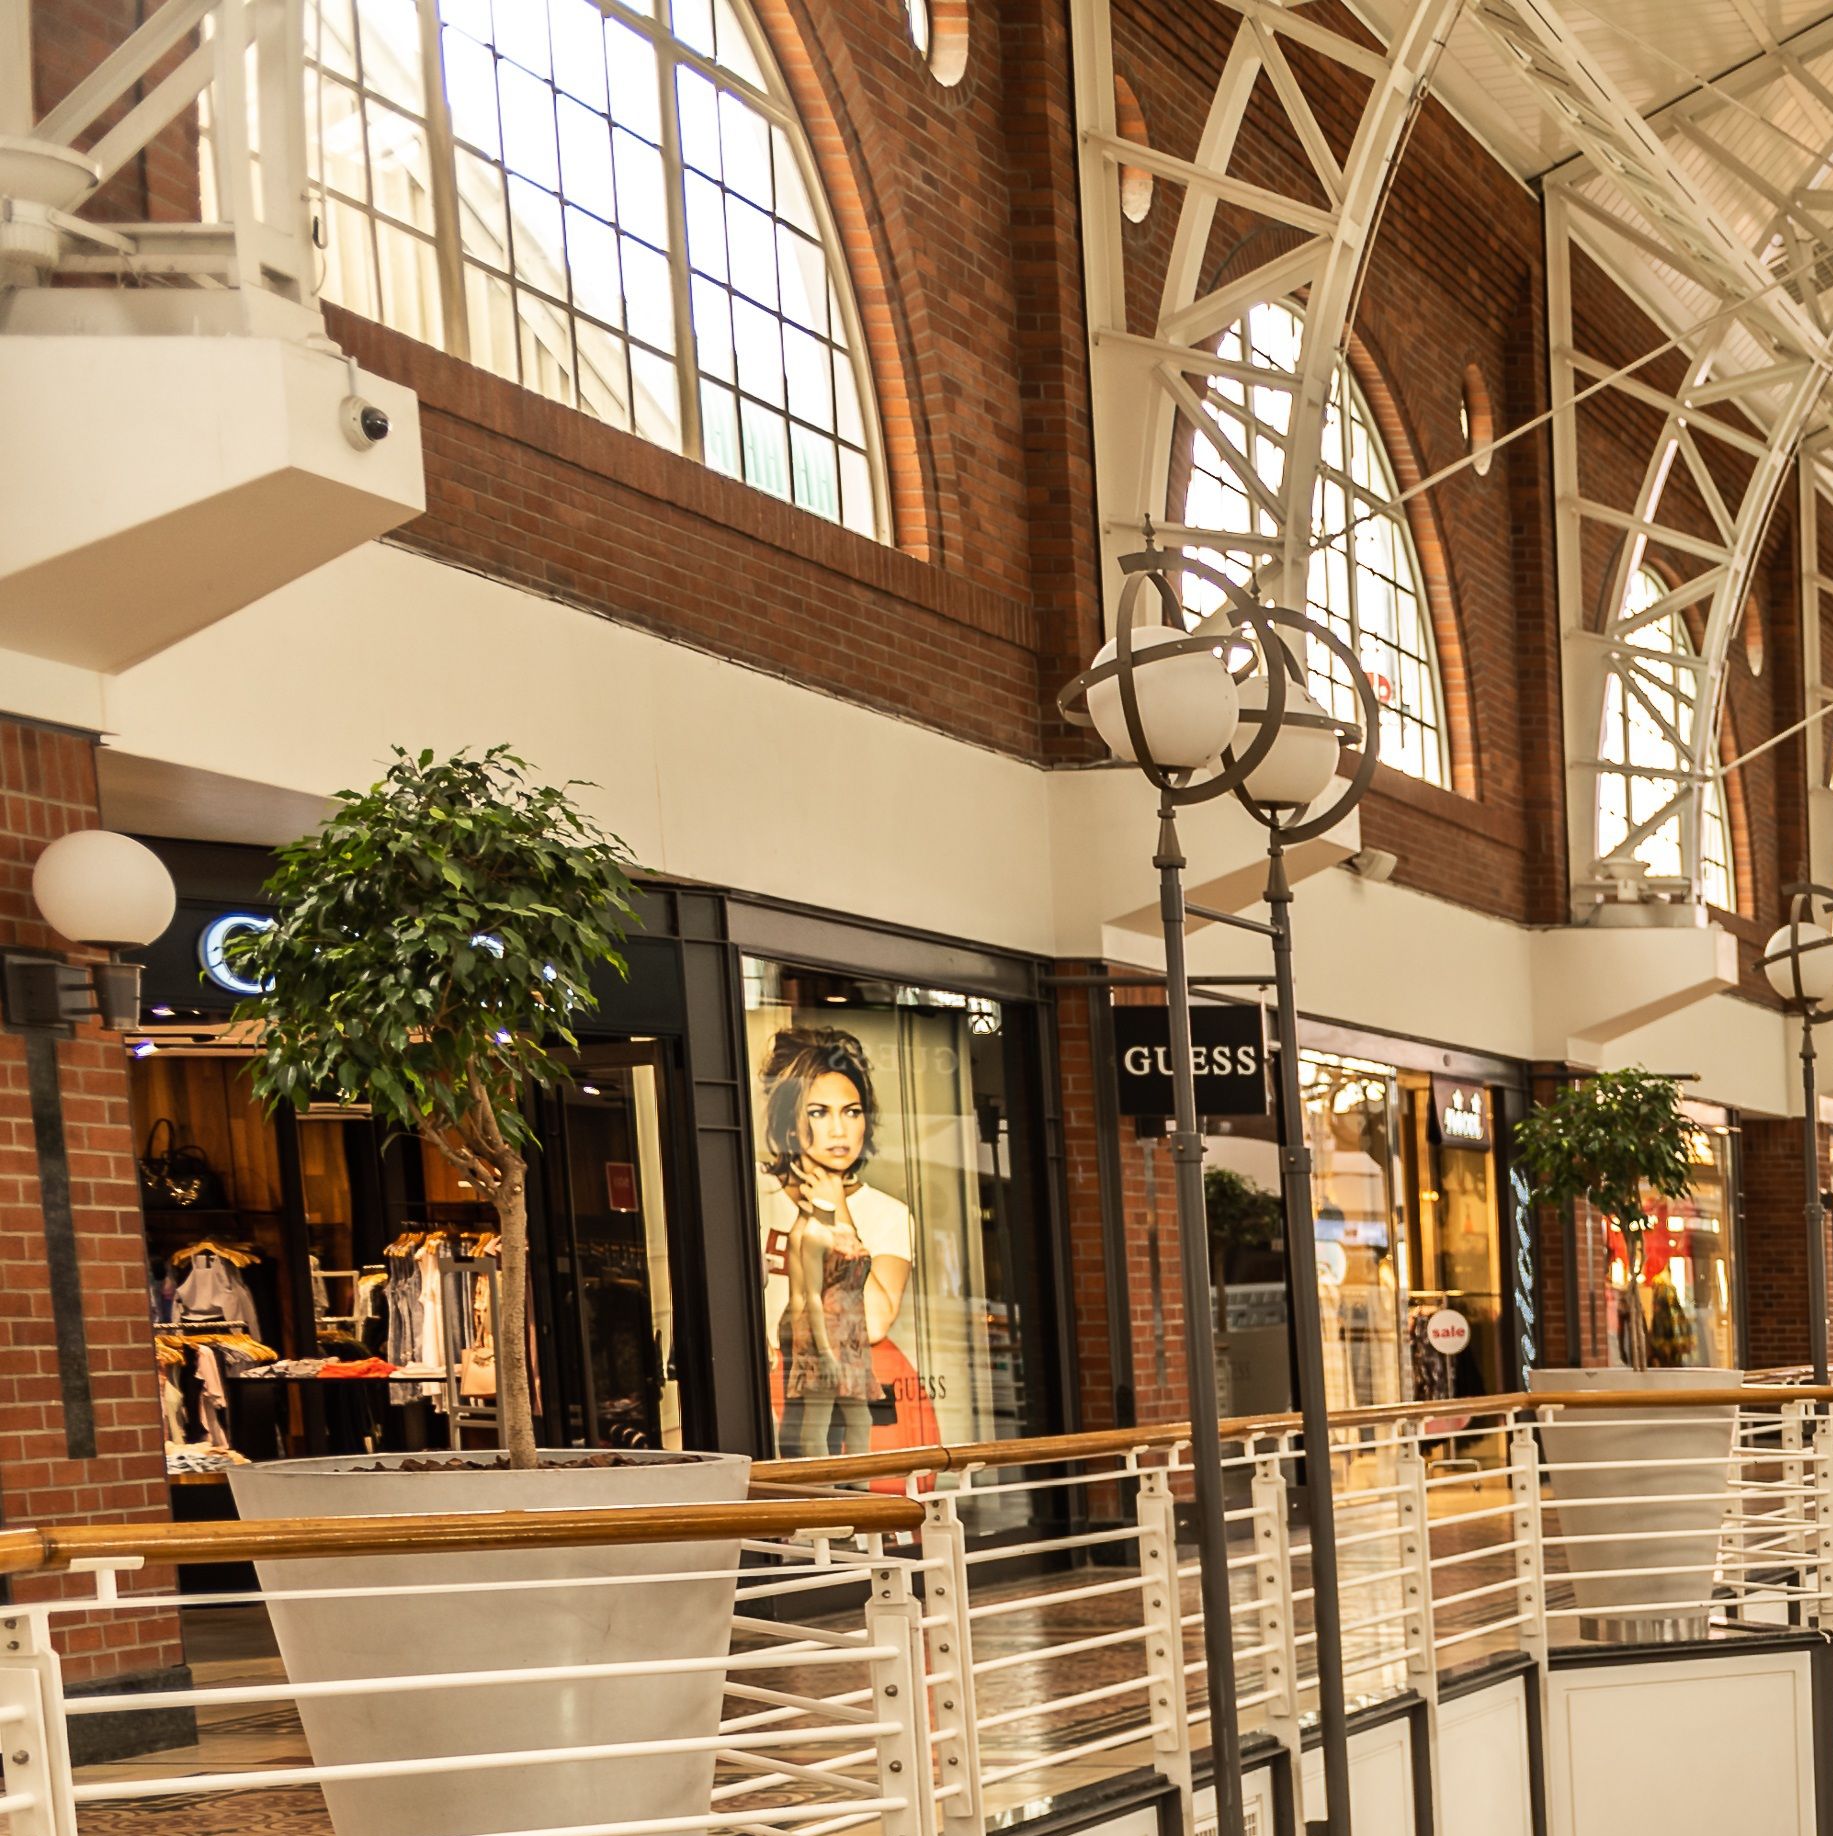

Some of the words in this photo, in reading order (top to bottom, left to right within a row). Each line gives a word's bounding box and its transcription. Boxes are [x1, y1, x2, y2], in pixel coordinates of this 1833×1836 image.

[1124, 1046, 1257, 1076] GUESS
[1431, 1326, 1466, 1339] sale
[893, 1375, 947, 1401] GUESS
